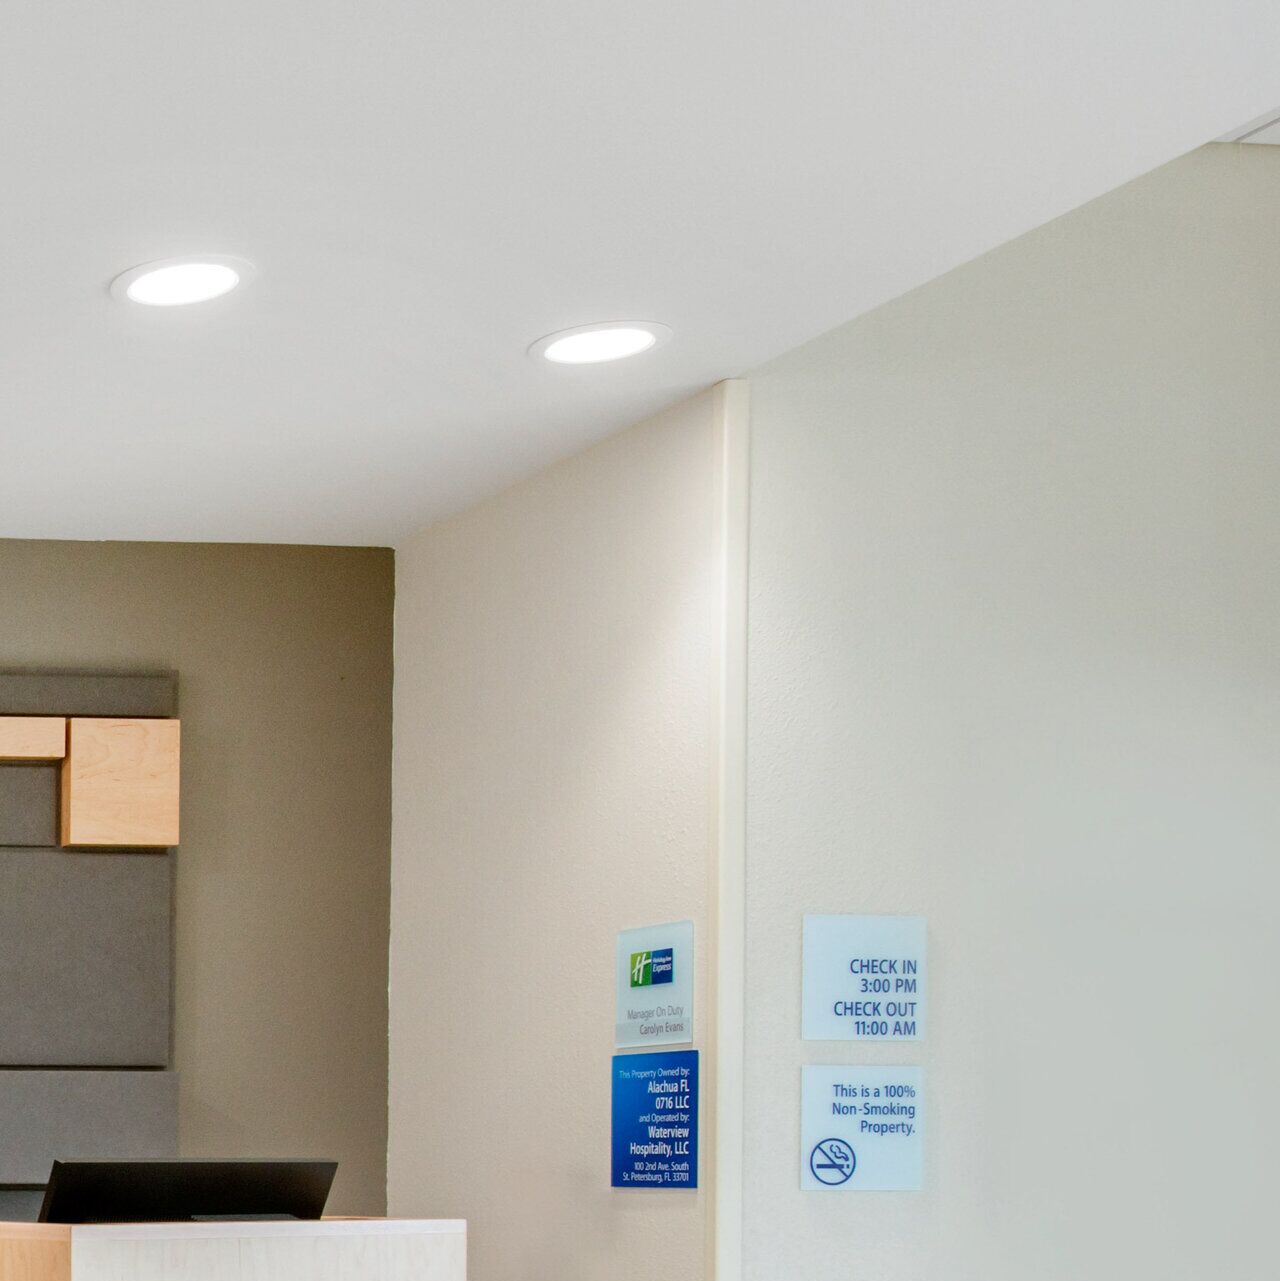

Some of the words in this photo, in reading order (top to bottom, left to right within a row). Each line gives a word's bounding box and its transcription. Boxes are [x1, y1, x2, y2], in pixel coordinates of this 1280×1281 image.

[652, 963, 672, 973] Express
[849, 959, 898, 974] CHECK
[902, 959, 917, 974] IN
[860, 978, 891, 993] 3:00
[895, 979, 917, 993] PM
[627, 1009, 655, 1021] Manager
[656, 1006, 666, 1017] On
[668, 1005, 684, 1017] Duty
[834, 1001, 882, 1017] CHECK
[886, 1001, 917, 1017] OUT
[640, 1023, 664, 1035] Carolyn
[665, 1021, 684, 1033] Evans
[854, 1021, 888, 1036] 11:00
[893, 1021, 916, 1036] AM
[620, 1070, 630, 1079] This
[631, 1069, 657, 1080] Property
[657, 1066, 679, 1077] Owned
[680, 1066, 690, 1077] by:
[647, 1080, 679, 1094] Alachua
[680, 1079, 690, 1092] FL
[832, 1084, 857, 1098] This
[861, 1084, 870, 1098] is
[873, 1087, 880, 1098] a
[884, 1084, 916, 1098] 100%
[655, 1096, 673, 1109] 0716
[675, 1095, 690, 1109] LLC
[832, 1102, 916, 1119] Non-Smoking
[639, 1114, 651, 1123] and
[651, 1112, 679, 1124] Operated
[680, 1112, 690, 1123] by:
[648, 1125, 690, 1138] Waterview
[860, 1120, 916, 1136] Property.
[630, 1141, 673, 1158] Hospitality,
[674, 1141, 690, 1154] LLC
[645, 1161, 657, 1171] 2nd
[657, 1161, 670, 1171] Ave.
[671, 1161, 689, 1171] South
[630, 1171, 663, 1184] Petersburg,
[664, 1172, 671, 1181] FL
[672, 1172, 689, 1182] 33701
